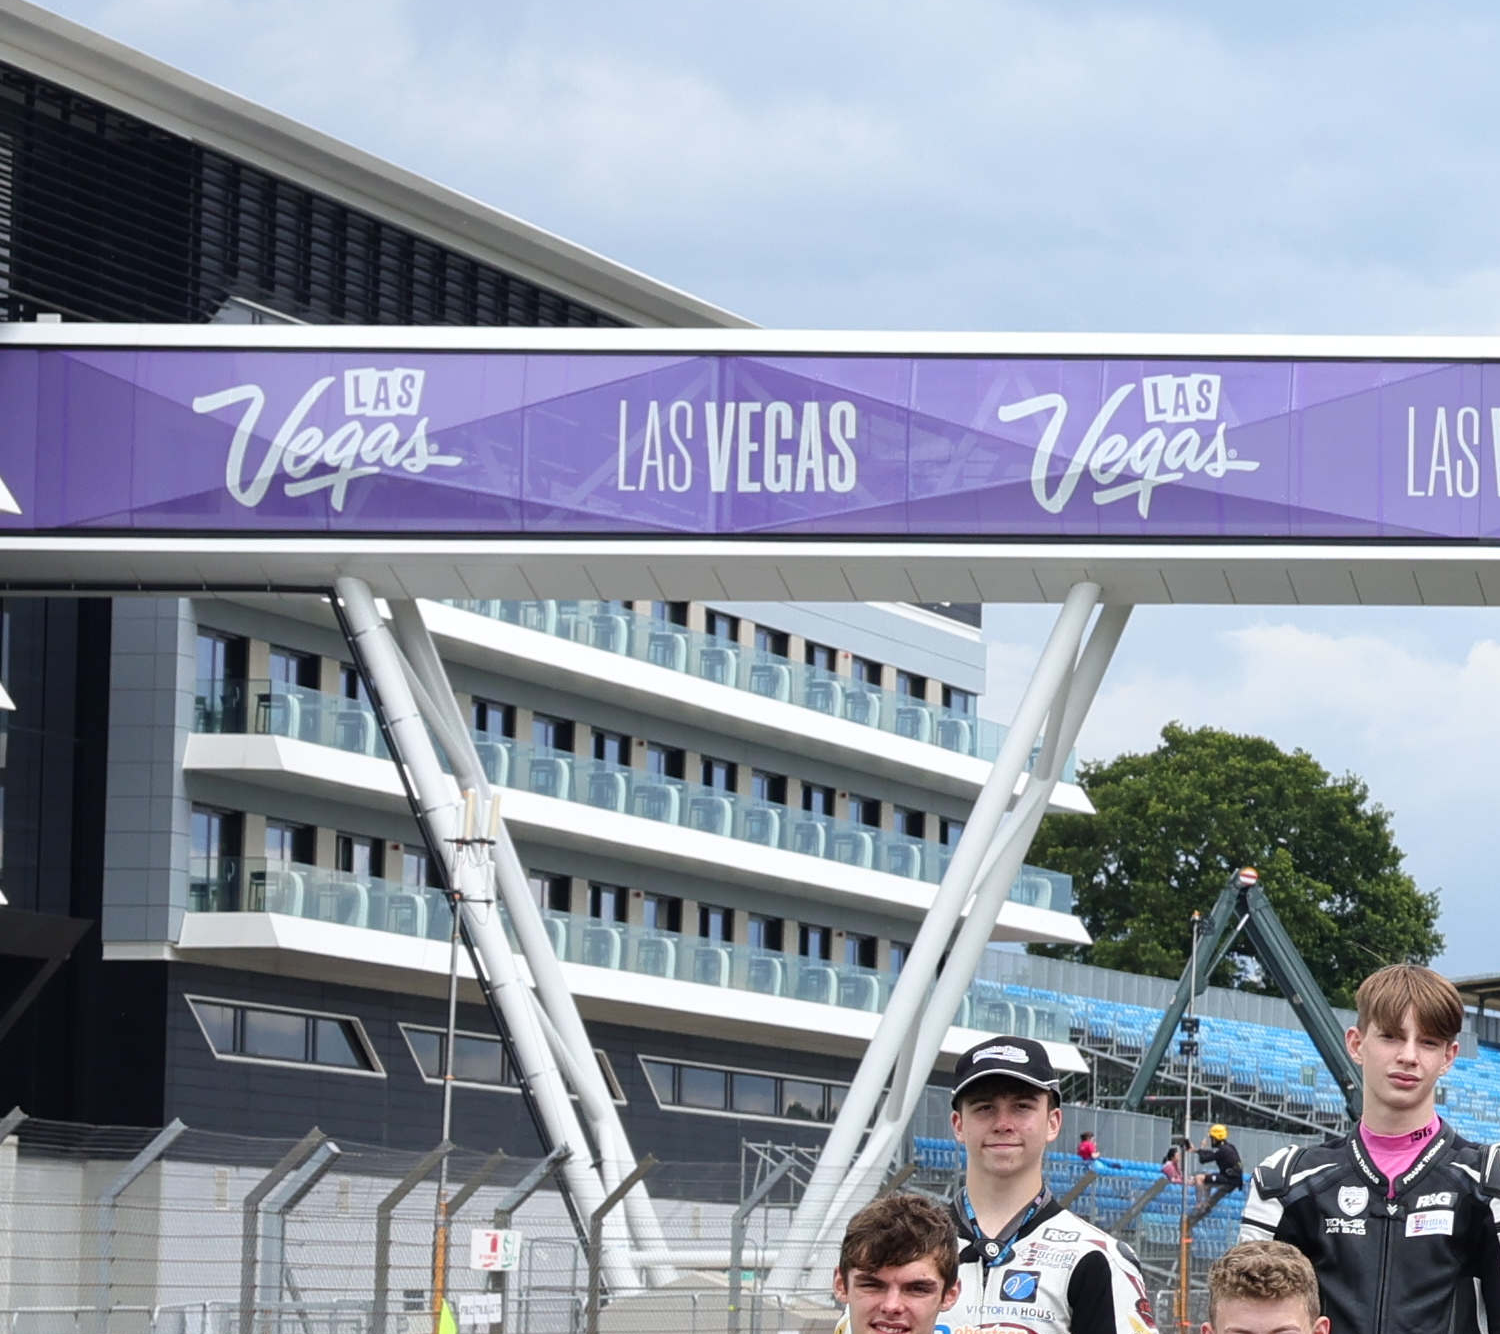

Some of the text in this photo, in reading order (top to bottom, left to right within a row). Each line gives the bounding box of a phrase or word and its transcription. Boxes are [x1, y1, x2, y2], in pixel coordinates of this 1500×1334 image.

[348, 372, 420, 413] LAS
[1147, 378, 1218, 419] LAS
[193, 383, 462, 511] Vegas
[619, 401, 856, 492] LAS VEGAS
[999, 385, 1259, 518] Vegas
[1408, 407, 1480, 499] LAS
[966, 1306, 1018, 1316] VICTORIA
